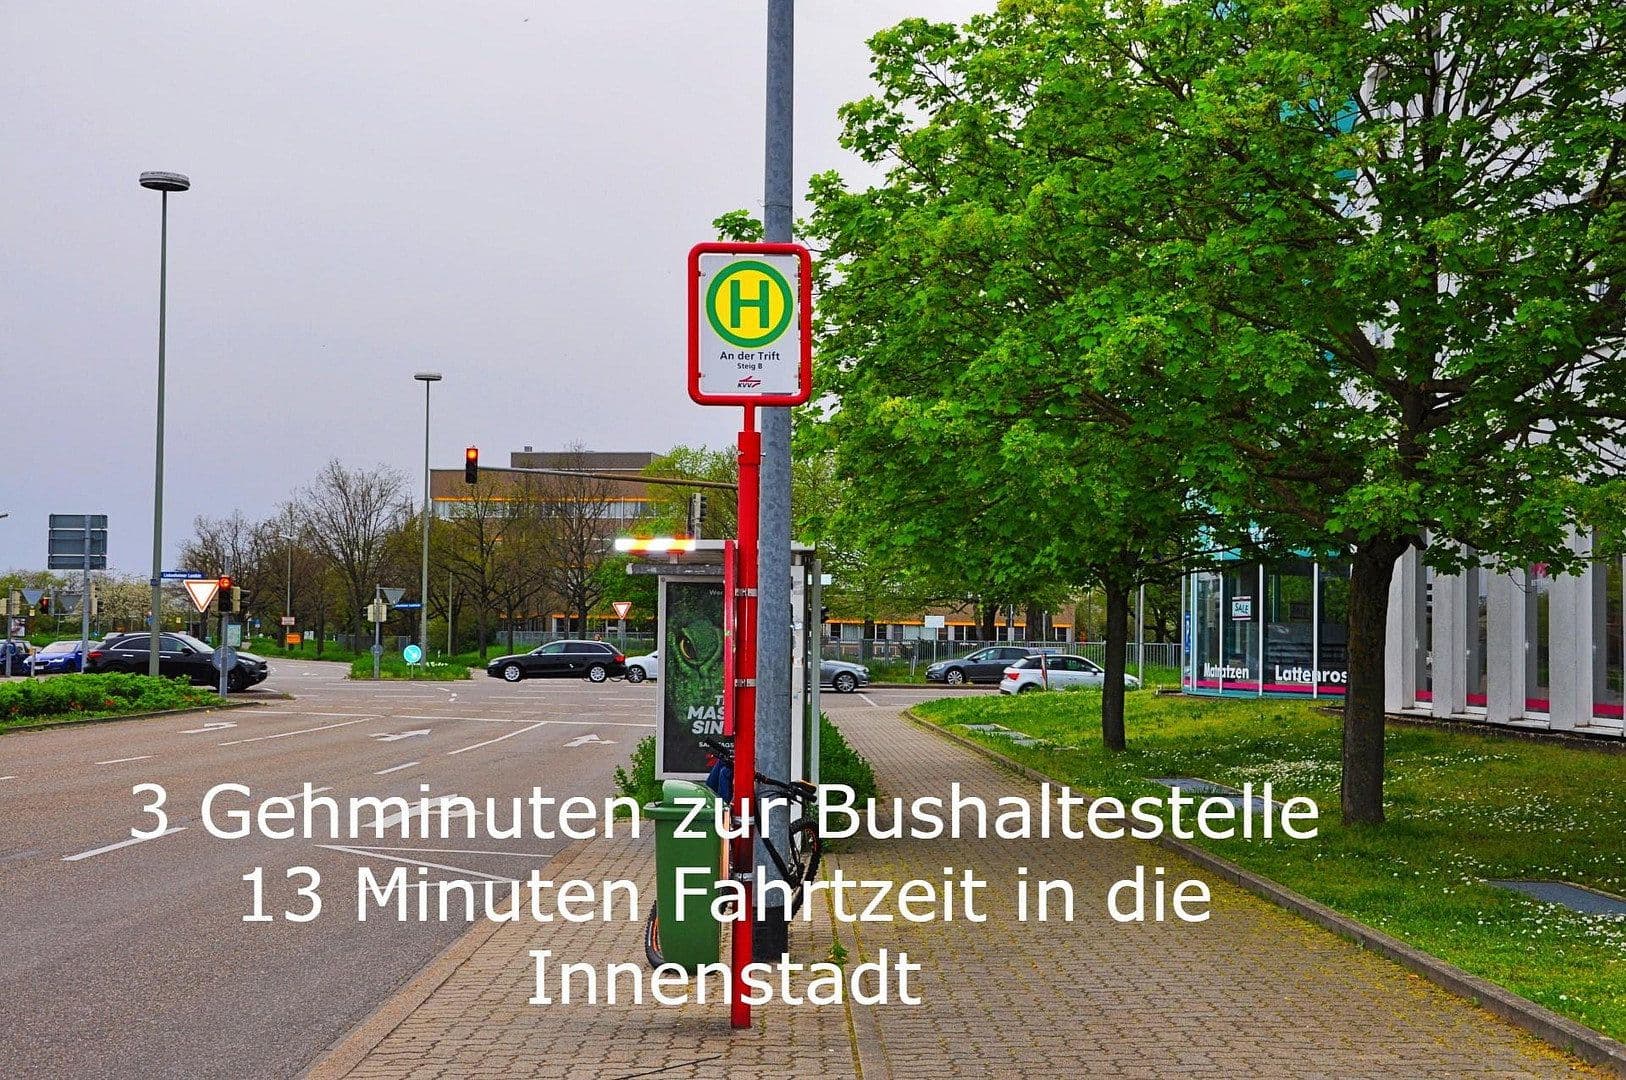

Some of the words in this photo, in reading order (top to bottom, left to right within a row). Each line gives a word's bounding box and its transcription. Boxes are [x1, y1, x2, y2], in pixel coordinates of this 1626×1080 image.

[731, 280, 769, 328] H
[720, 351, 735, 360] An
[737, 350, 755, 360] der
[757, 350, 781, 361] Trift
[737, 362, 756, 371] Steig
[757, 362, 763, 370] B
[1204, 662, 1249, 679] Matratzen
